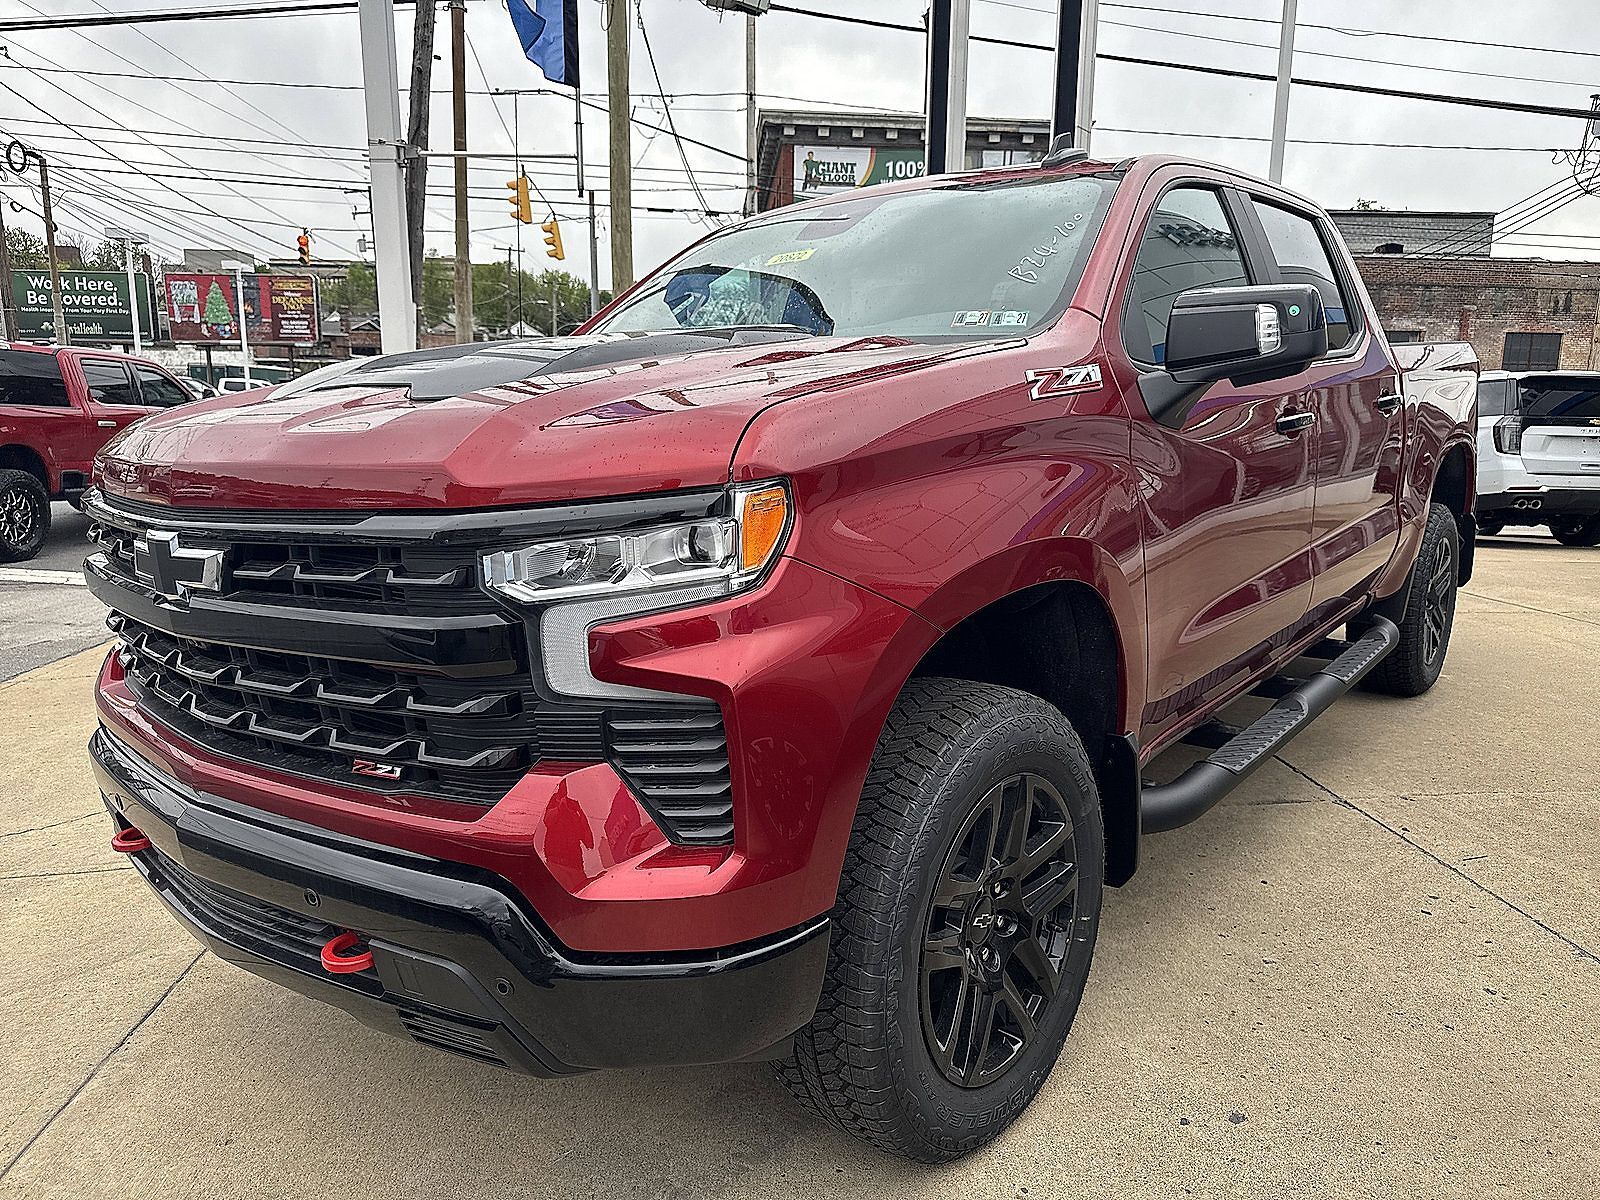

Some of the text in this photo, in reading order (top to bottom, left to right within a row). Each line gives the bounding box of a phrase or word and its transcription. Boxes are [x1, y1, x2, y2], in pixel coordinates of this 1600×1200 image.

[817, 161, 857, 175] GIANT
[27, 275, 118, 291] Wok Here.
[26, 290, 48, 305] Be
[978, 313, 988, 323] 27
[1016, 313, 1027, 324] 27
[1024, 364, 1103, 400] Z71
[351, 759, 402, 780] Z71
